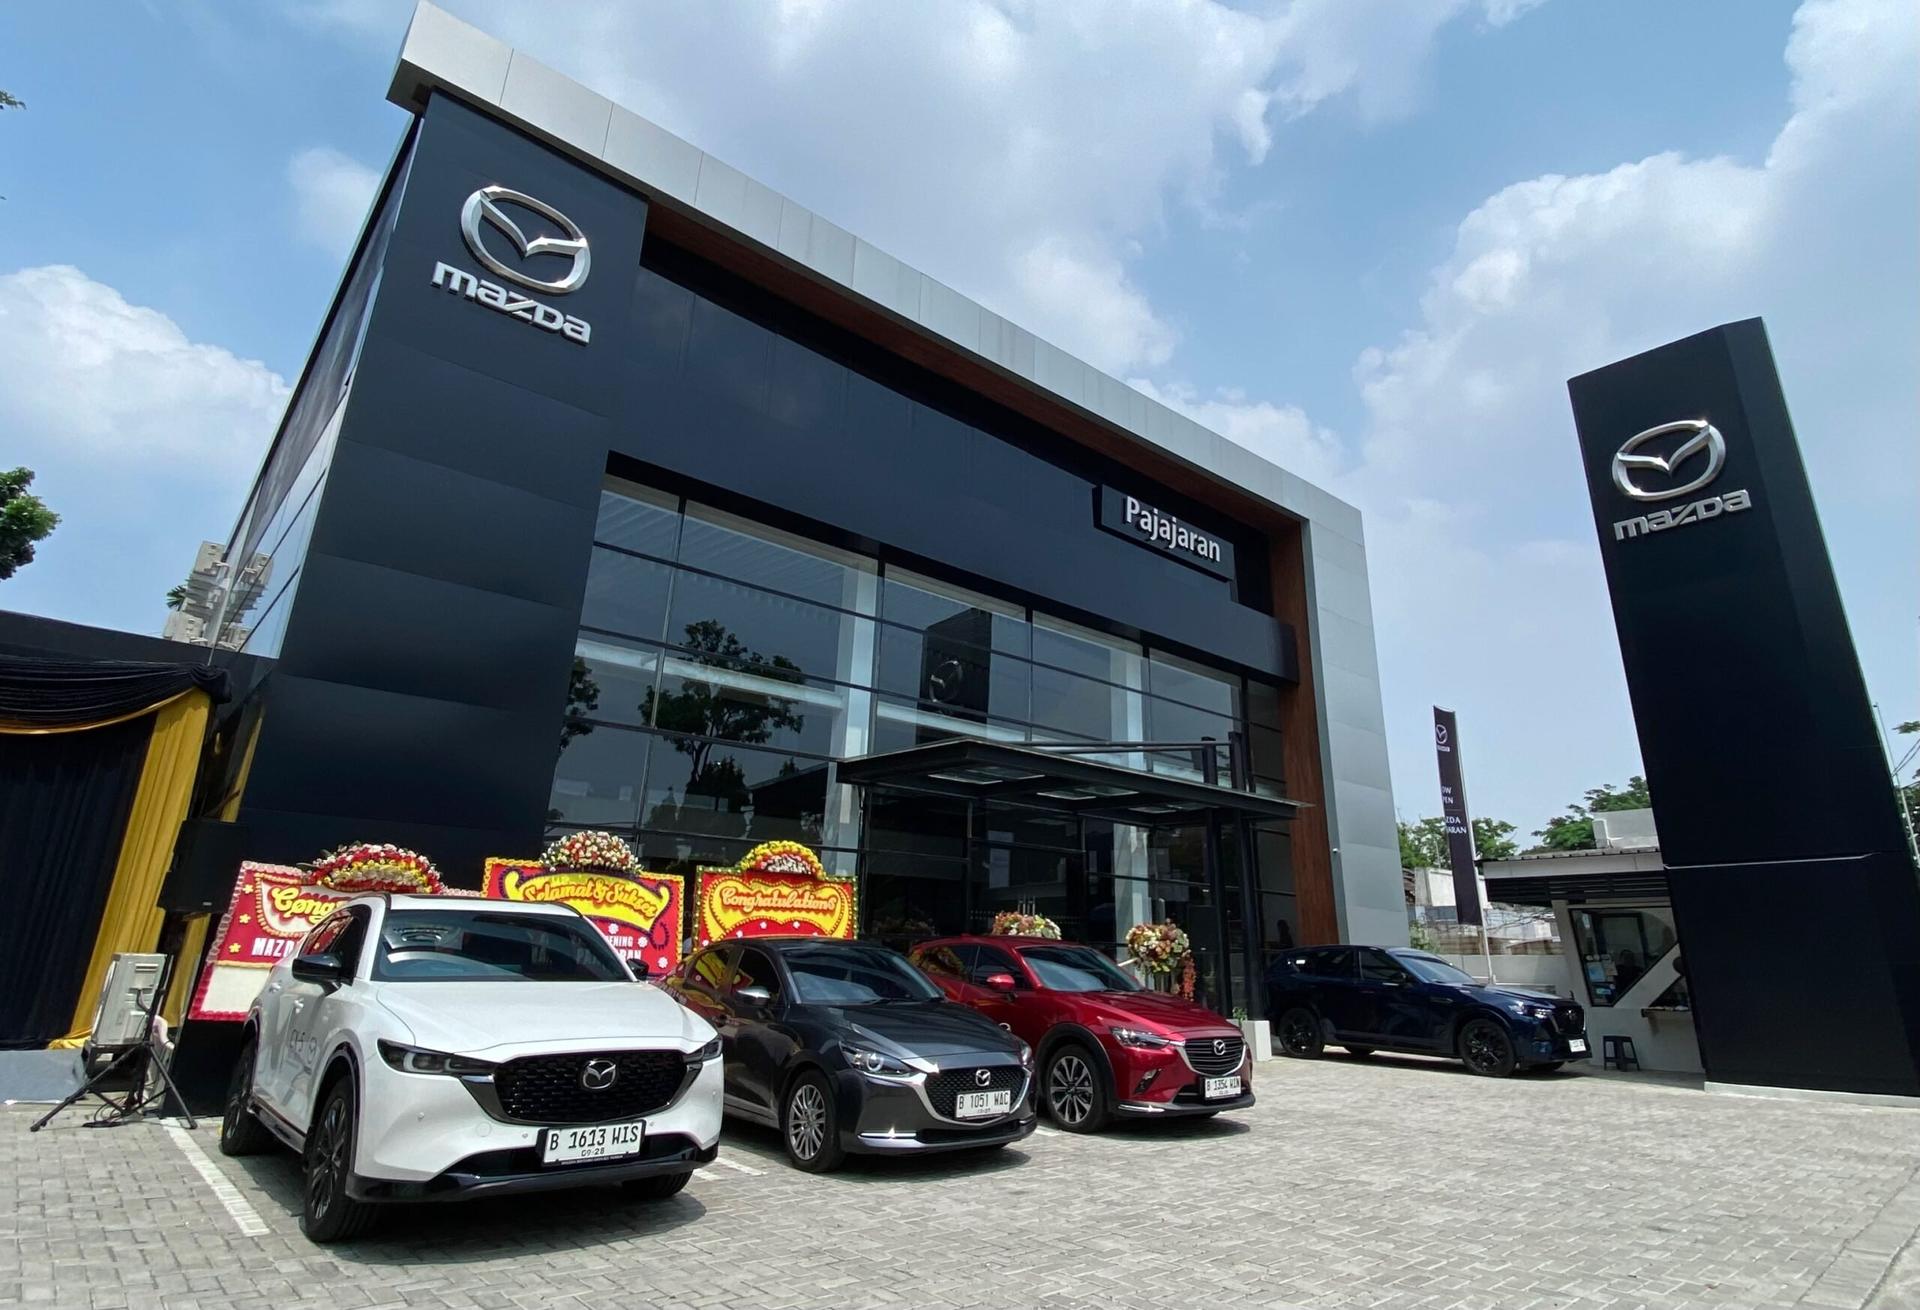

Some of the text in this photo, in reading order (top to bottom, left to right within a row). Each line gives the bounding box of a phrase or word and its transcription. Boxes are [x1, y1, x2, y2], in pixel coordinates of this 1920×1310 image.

[1126, 496, 1220, 562] Pajajaran
[525, 879, 658, 917] Selamat & Sukses
[722, 887, 836, 912] Congratulations
[959, 1096, 964, 1109] B
[970, 1094, 989, 1109] 1051
[549, 1125, 638, 1151] B 1613 WIS
